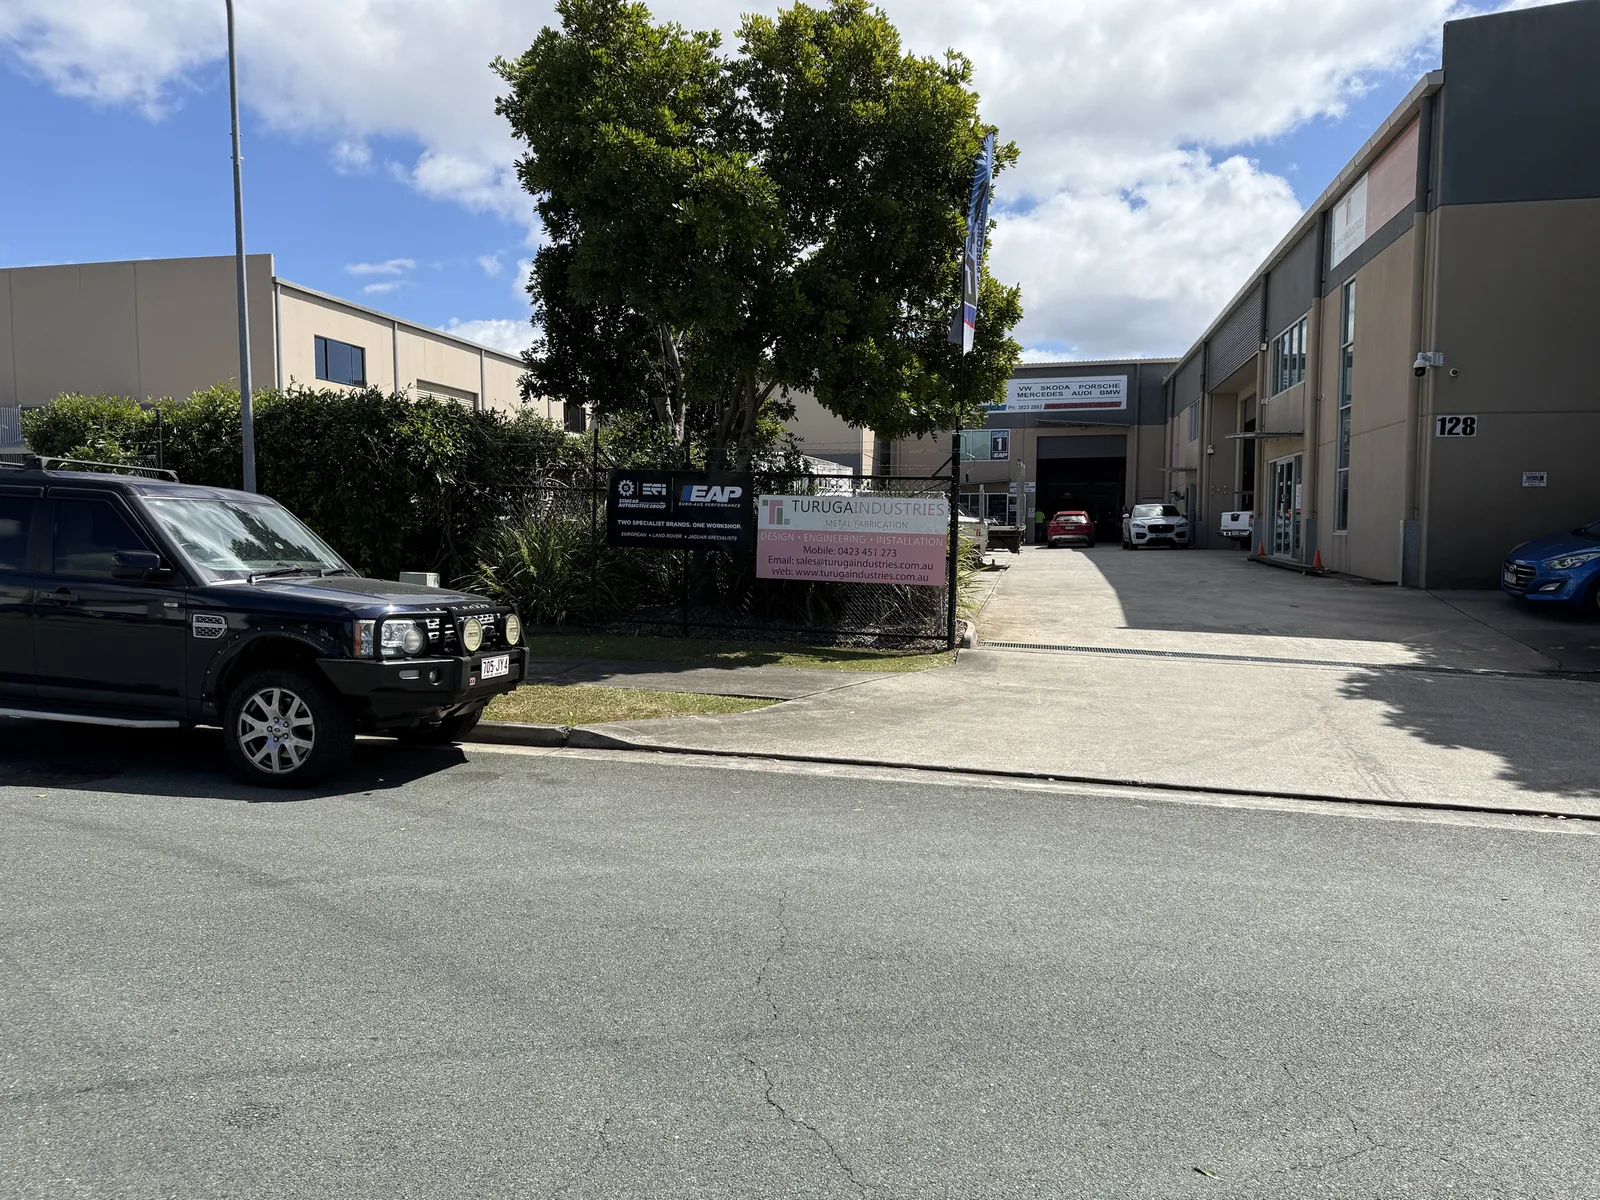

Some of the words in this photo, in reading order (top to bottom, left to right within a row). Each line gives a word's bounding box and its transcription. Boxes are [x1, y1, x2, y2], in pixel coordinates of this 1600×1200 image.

[1437, 416, 1476, 436] 128
[996, 437, 1003, 450] 1
[689, 485, 743, 503] EAP
[706, 522, 742, 530] WORKSHOP.
[824, 519, 852, 528] METAL
[854, 520, 909, 530] FABRICATION
[760, 531, 795, 542] DESIGN
[803, 533, 867, 545] ENGINEERING
[876, 536, 943, 547] INSTALLATION
[803, 545, 836, 556] Mobile:
[837, 547, 860, 556] 0423
[861, 548, 878, 557] 451
[880, 548, 898, 558] 273
[768, 555, 794, 565] Email:
[795, 557, 934, 571] sales@turugaindustries.com.au
[771, 566, 794, 576] Web:
[795, 569, 929, 582] www.turugaindustries.com.au
